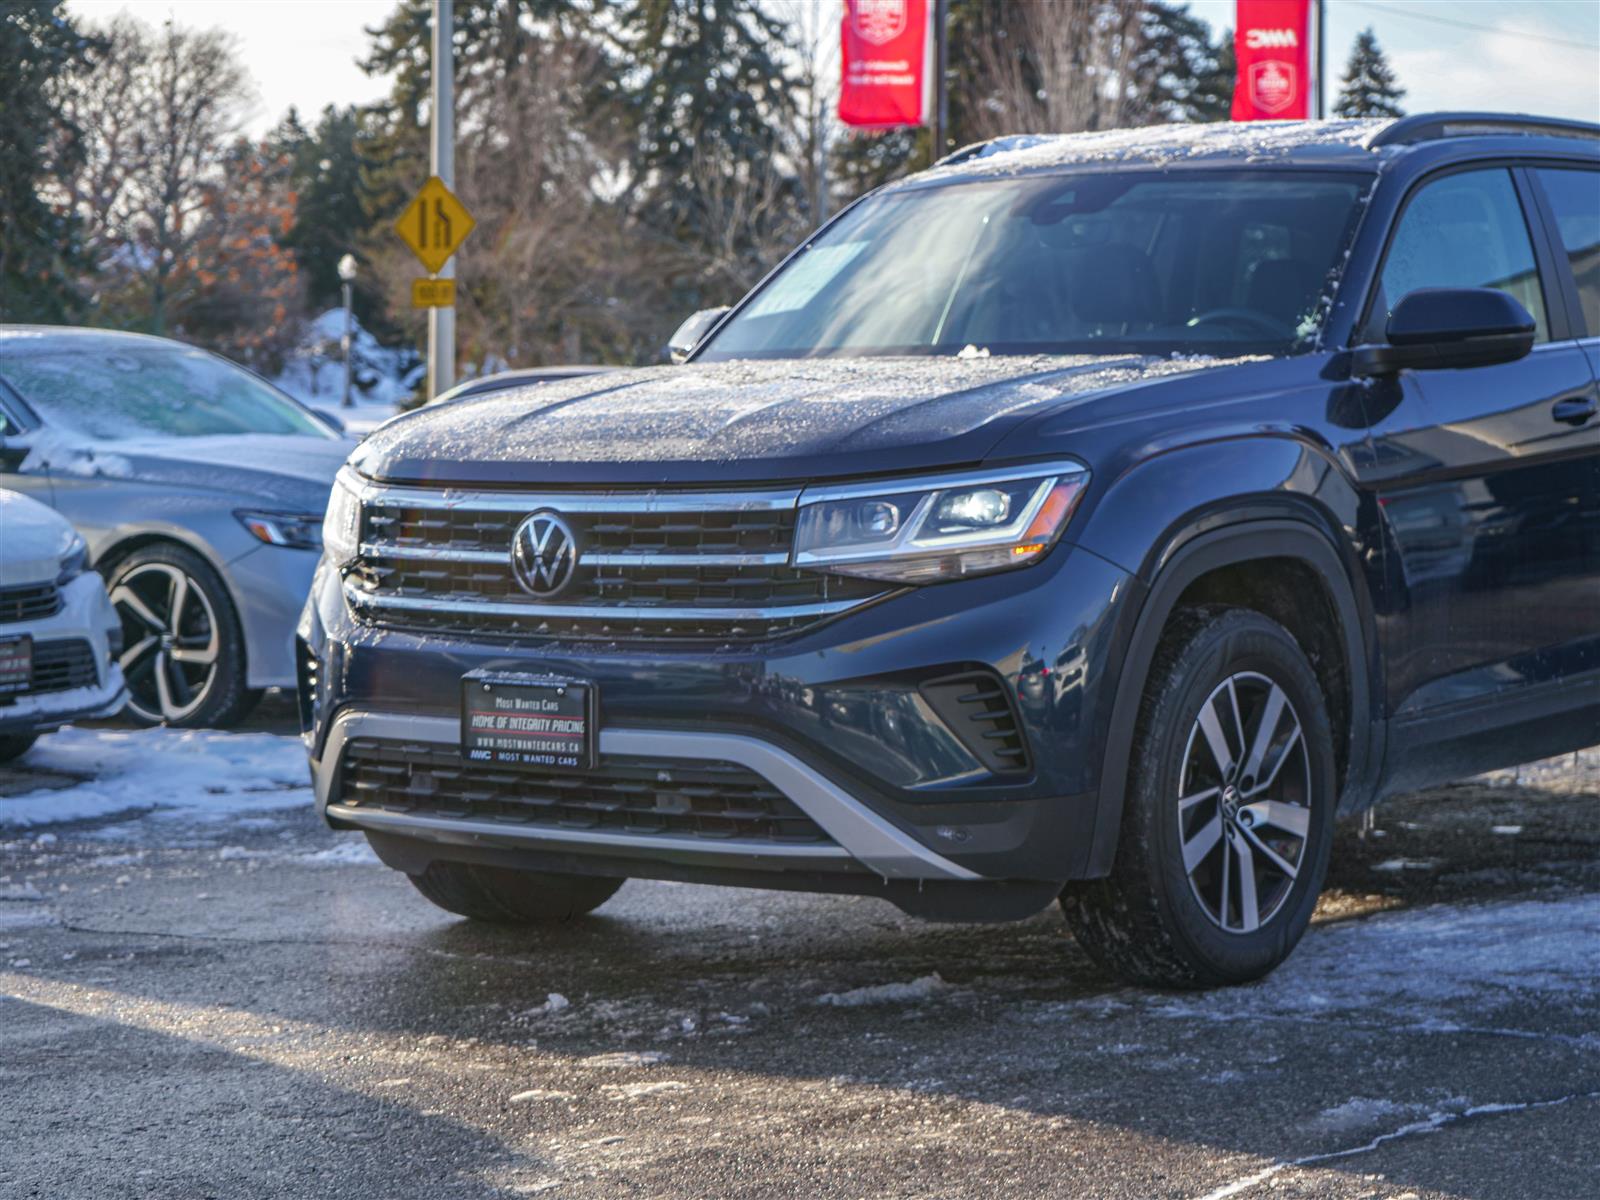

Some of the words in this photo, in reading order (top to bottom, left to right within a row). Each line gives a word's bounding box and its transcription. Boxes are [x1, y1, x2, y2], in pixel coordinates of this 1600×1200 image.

[472, 715, 495, 728] HOME
[496, 716, 508, 728] OF
[509, 717, 551, 731] INTEGRITY
[552, 719, 585, 733] PRICING
[498, 752, 520, 761] MOST
[523, 754, 556, 764] WANTED
[558, 756, 578, 766] CARS
